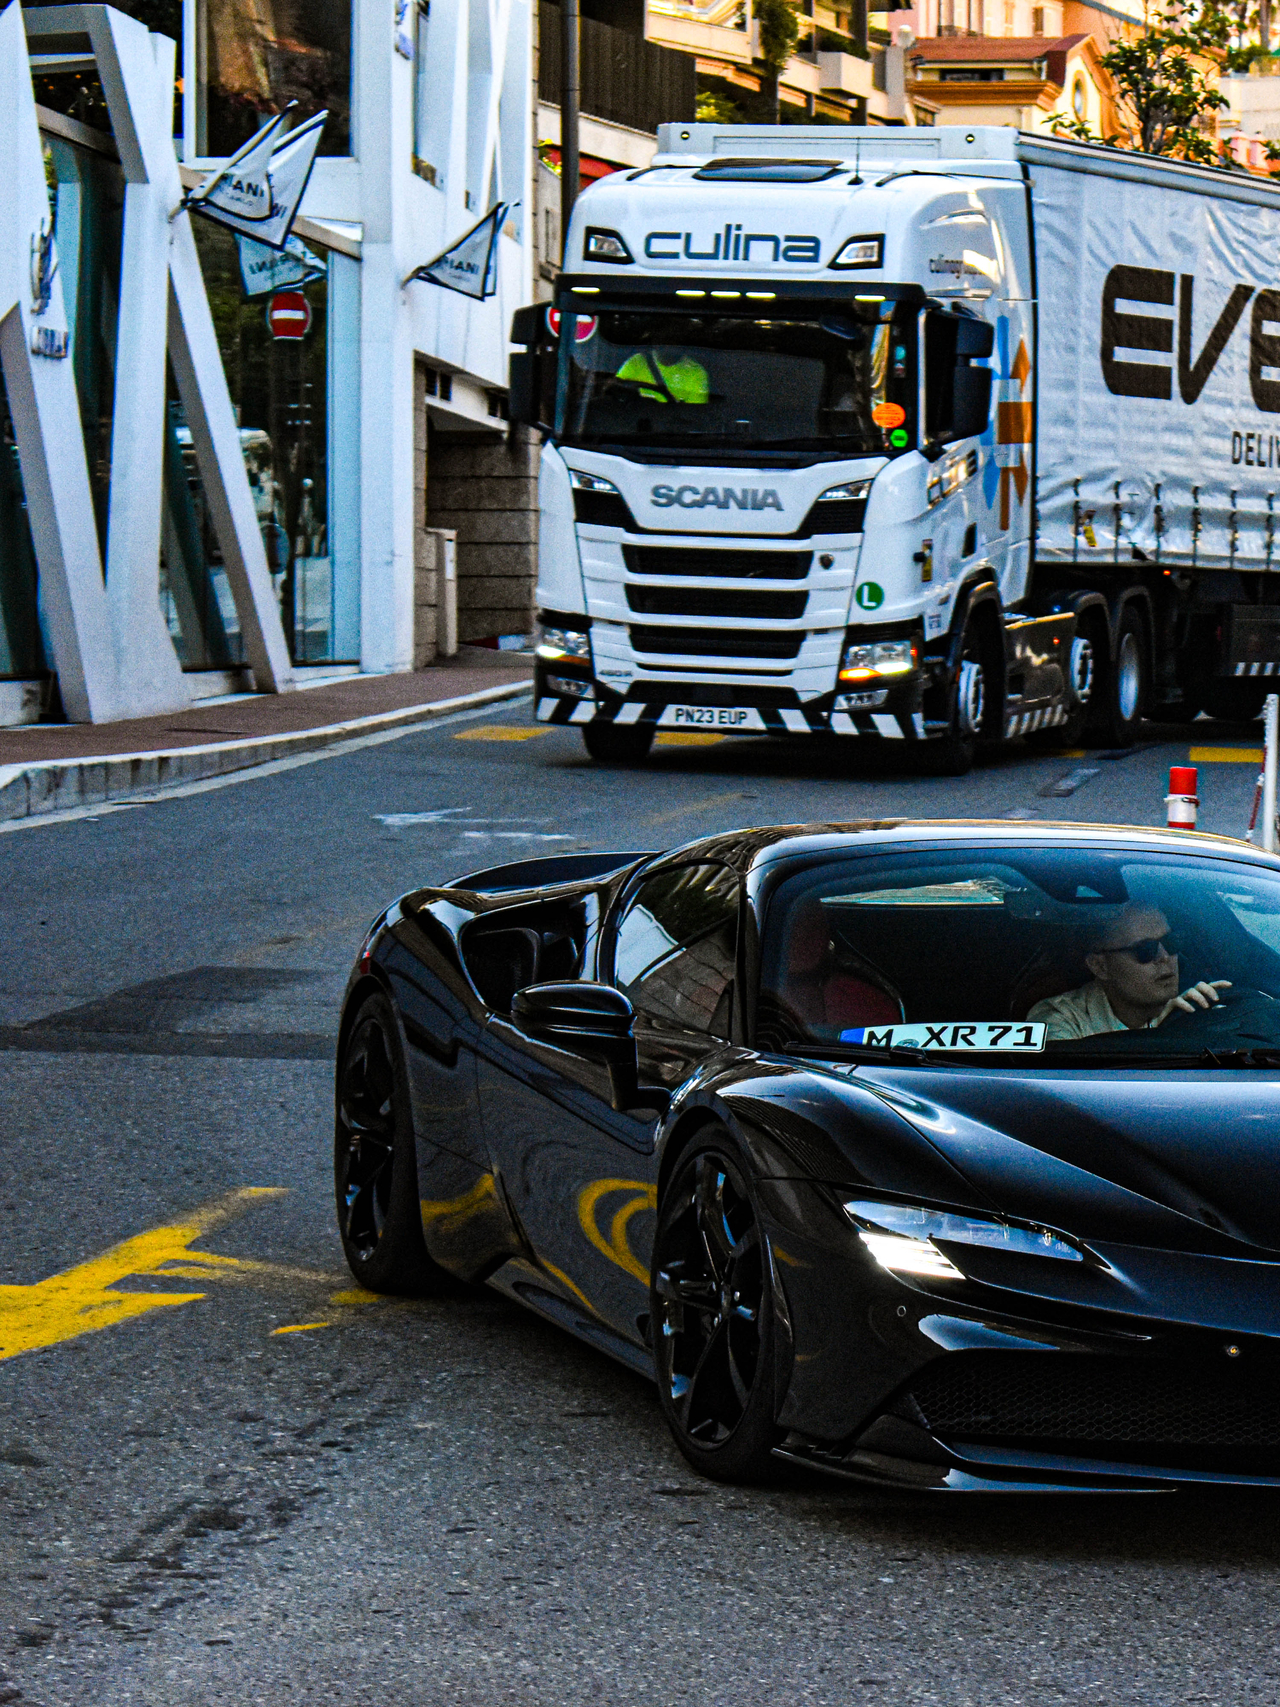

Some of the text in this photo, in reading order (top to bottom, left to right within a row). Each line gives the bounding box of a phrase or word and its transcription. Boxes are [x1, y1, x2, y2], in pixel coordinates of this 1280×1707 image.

[644, 223, 821, 263] culina
[650, 483, 785, 512] SCANIA
[862, 585, 878, 607] L
[675, 707, 748, 725] PN23 EUP
[866, 1025, 1038, 1048] M XR 71
